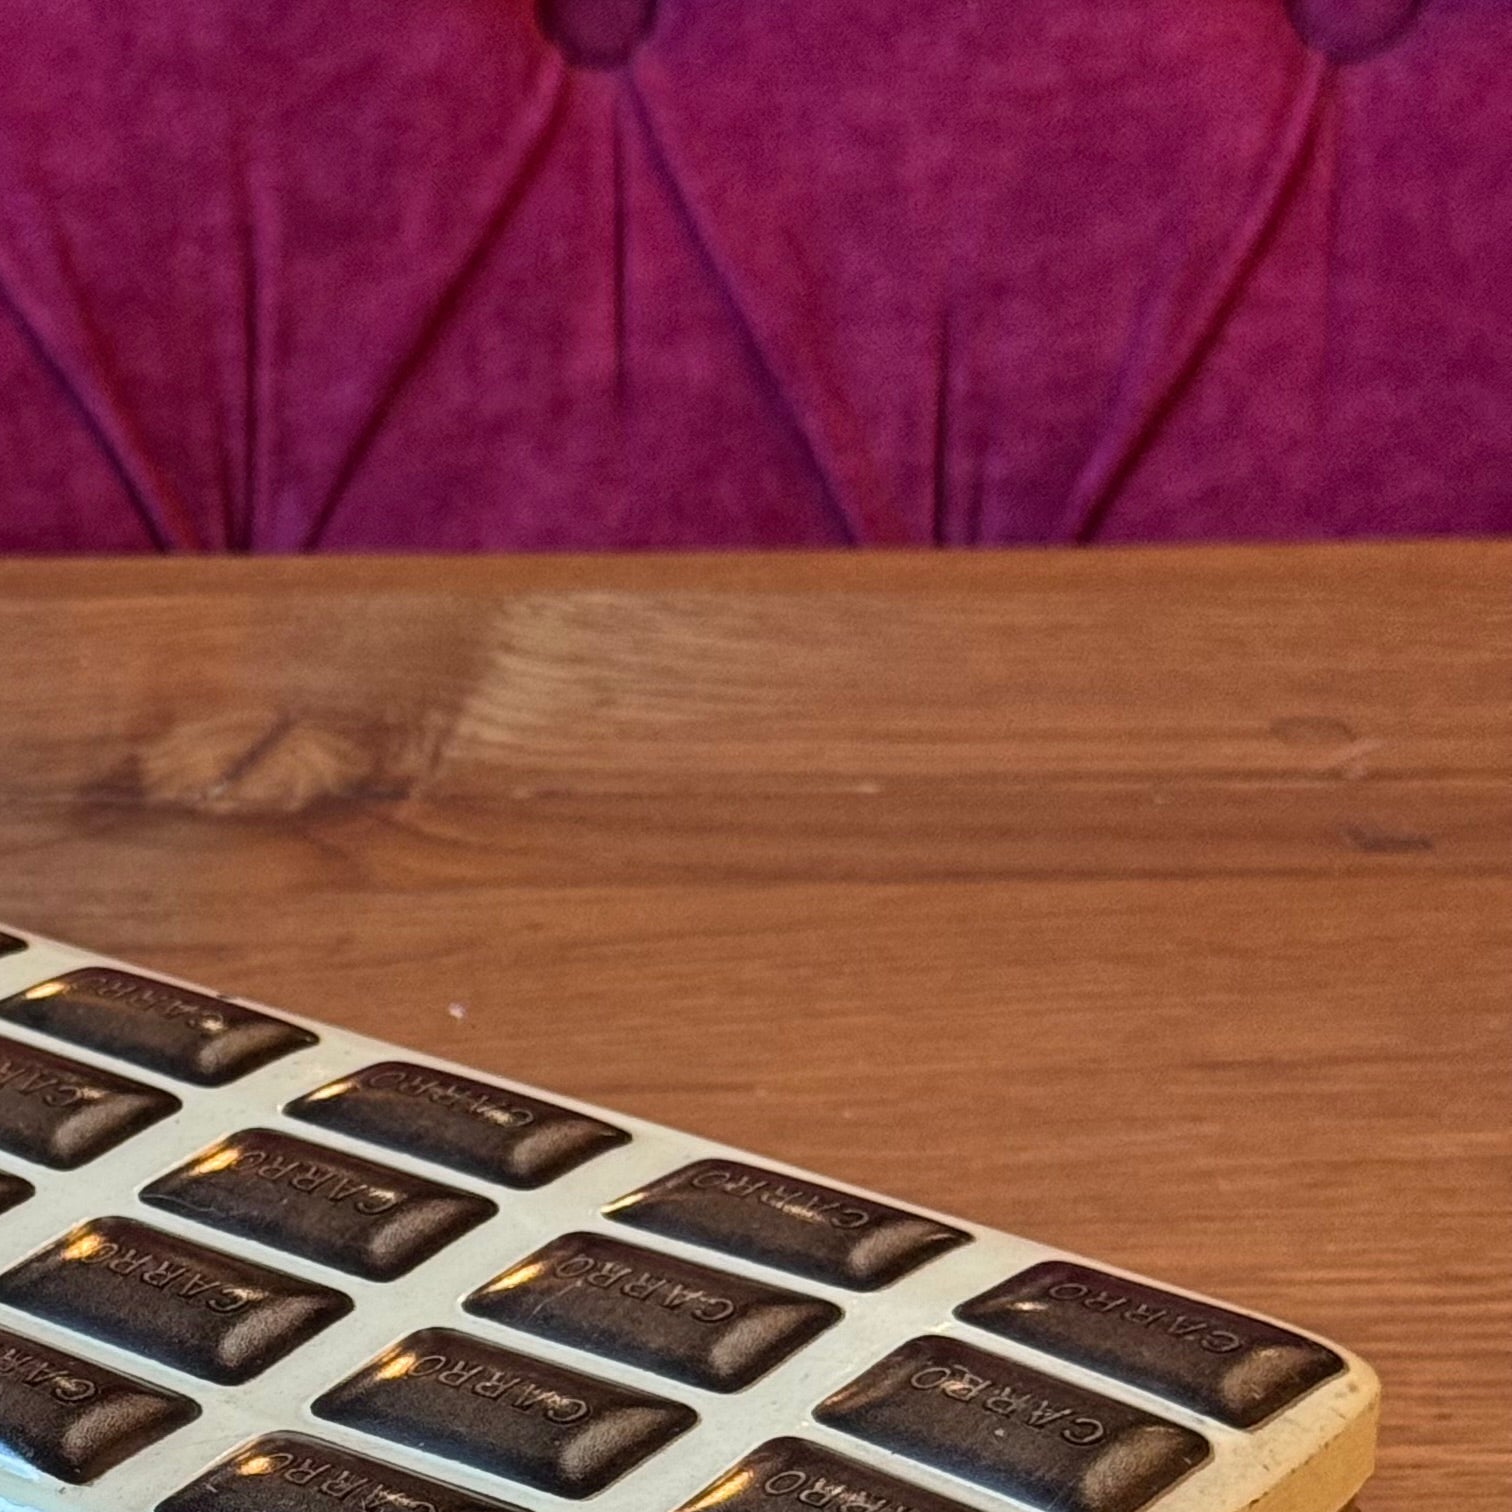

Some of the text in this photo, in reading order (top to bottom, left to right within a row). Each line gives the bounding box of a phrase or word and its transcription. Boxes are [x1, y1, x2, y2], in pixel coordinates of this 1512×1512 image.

[77, 1240, 254, 1315] CARRO
[553, 1253, 736, 1323] CARRO
[1048, 1282, 1243, 1354] CARRO
[405, 1353, 591, 1425] CARRO
[909, 1364, 1106, 1446] CARRO
